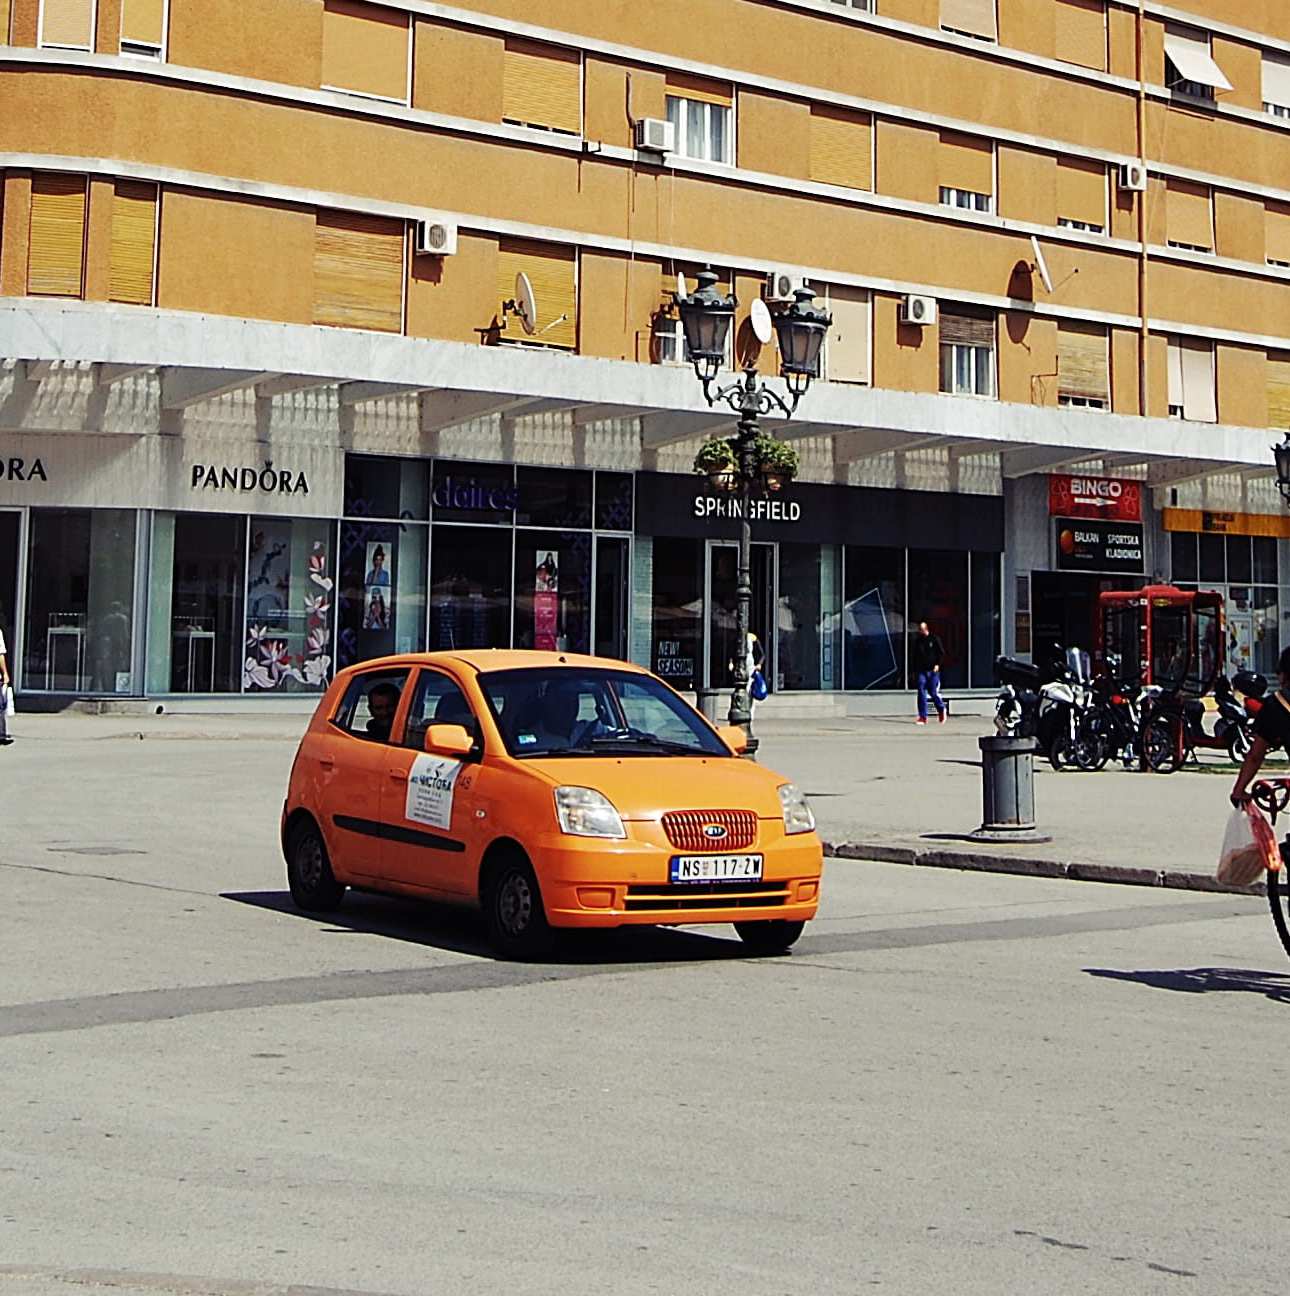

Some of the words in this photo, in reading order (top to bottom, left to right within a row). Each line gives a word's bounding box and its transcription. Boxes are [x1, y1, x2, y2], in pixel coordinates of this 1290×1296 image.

[192, 464, 309, 494] PANDORA
[1071, 478, 1122, 497] BINGO
[682, 859, 701, 877] NS
